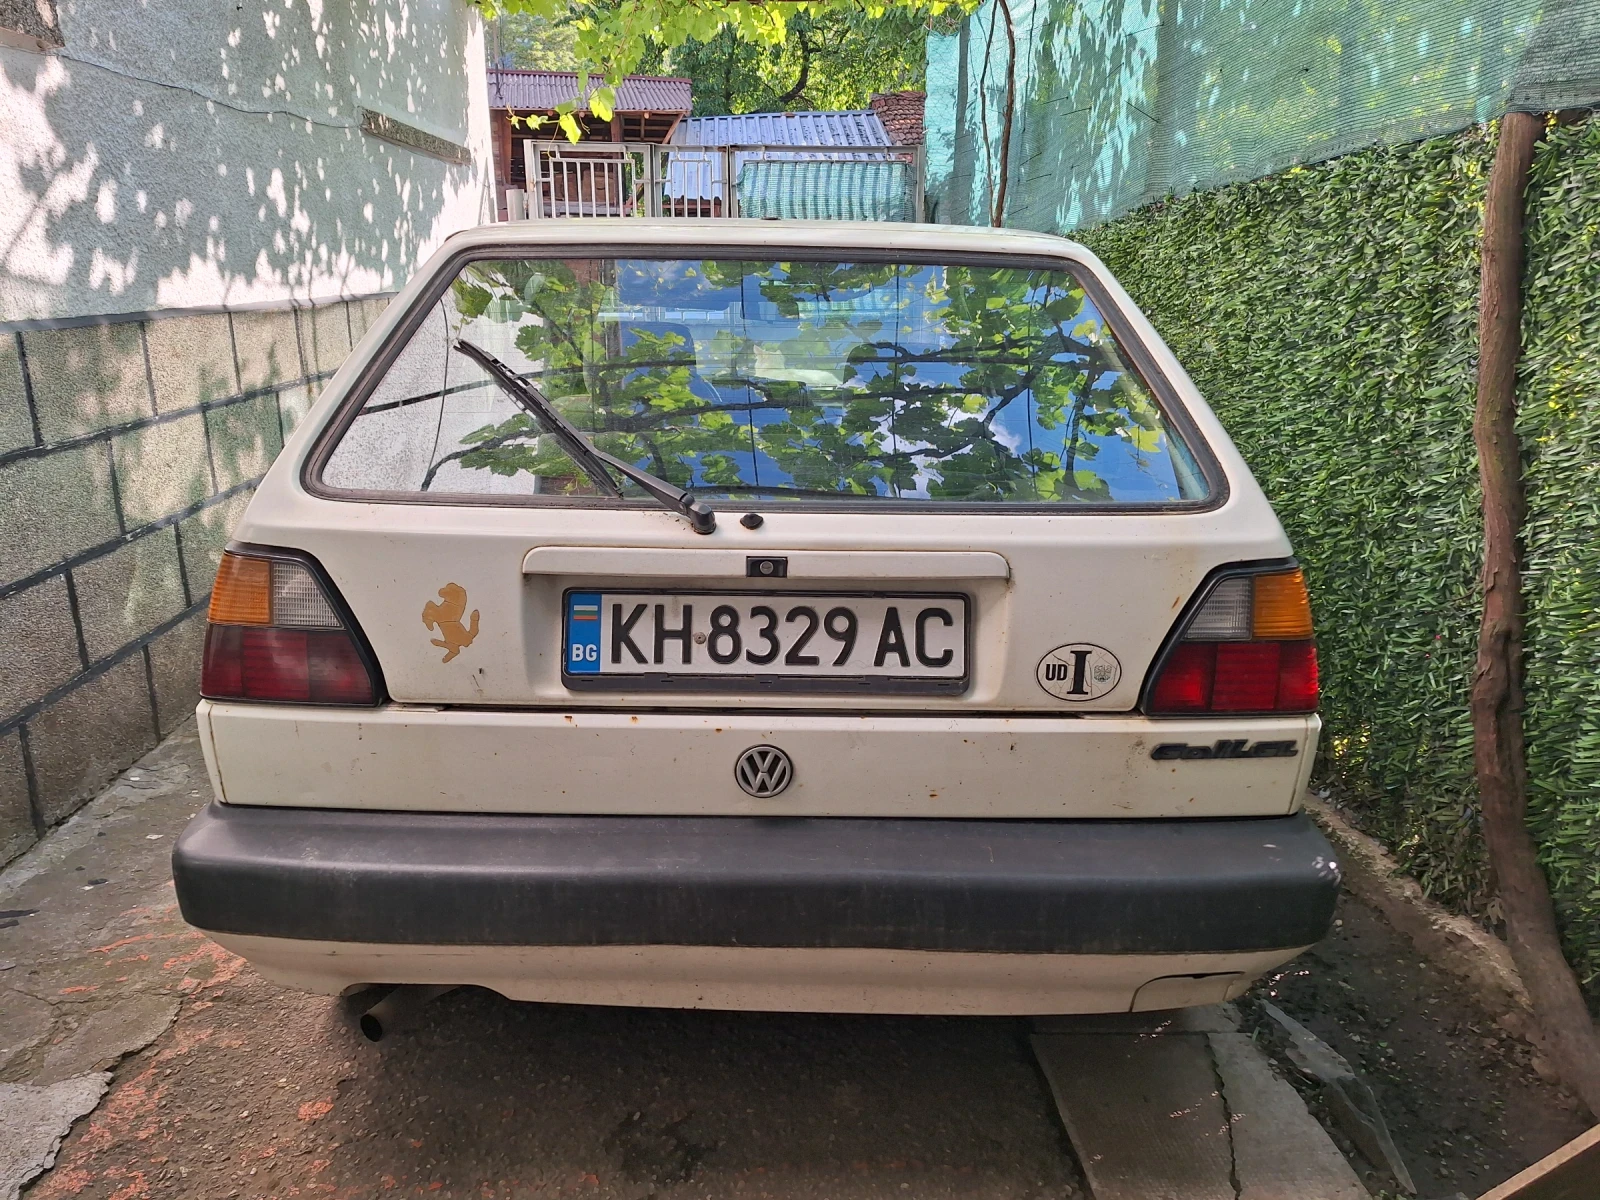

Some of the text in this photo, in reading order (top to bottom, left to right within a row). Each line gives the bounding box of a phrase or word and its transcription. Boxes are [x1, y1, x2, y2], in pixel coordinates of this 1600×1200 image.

[571, 643, 598, 662] BG
[610, 603, 954, 668] KH 8329 AC
[1045, 650, 1093, 695] UD I
[737, 746, 791, 796] VW
